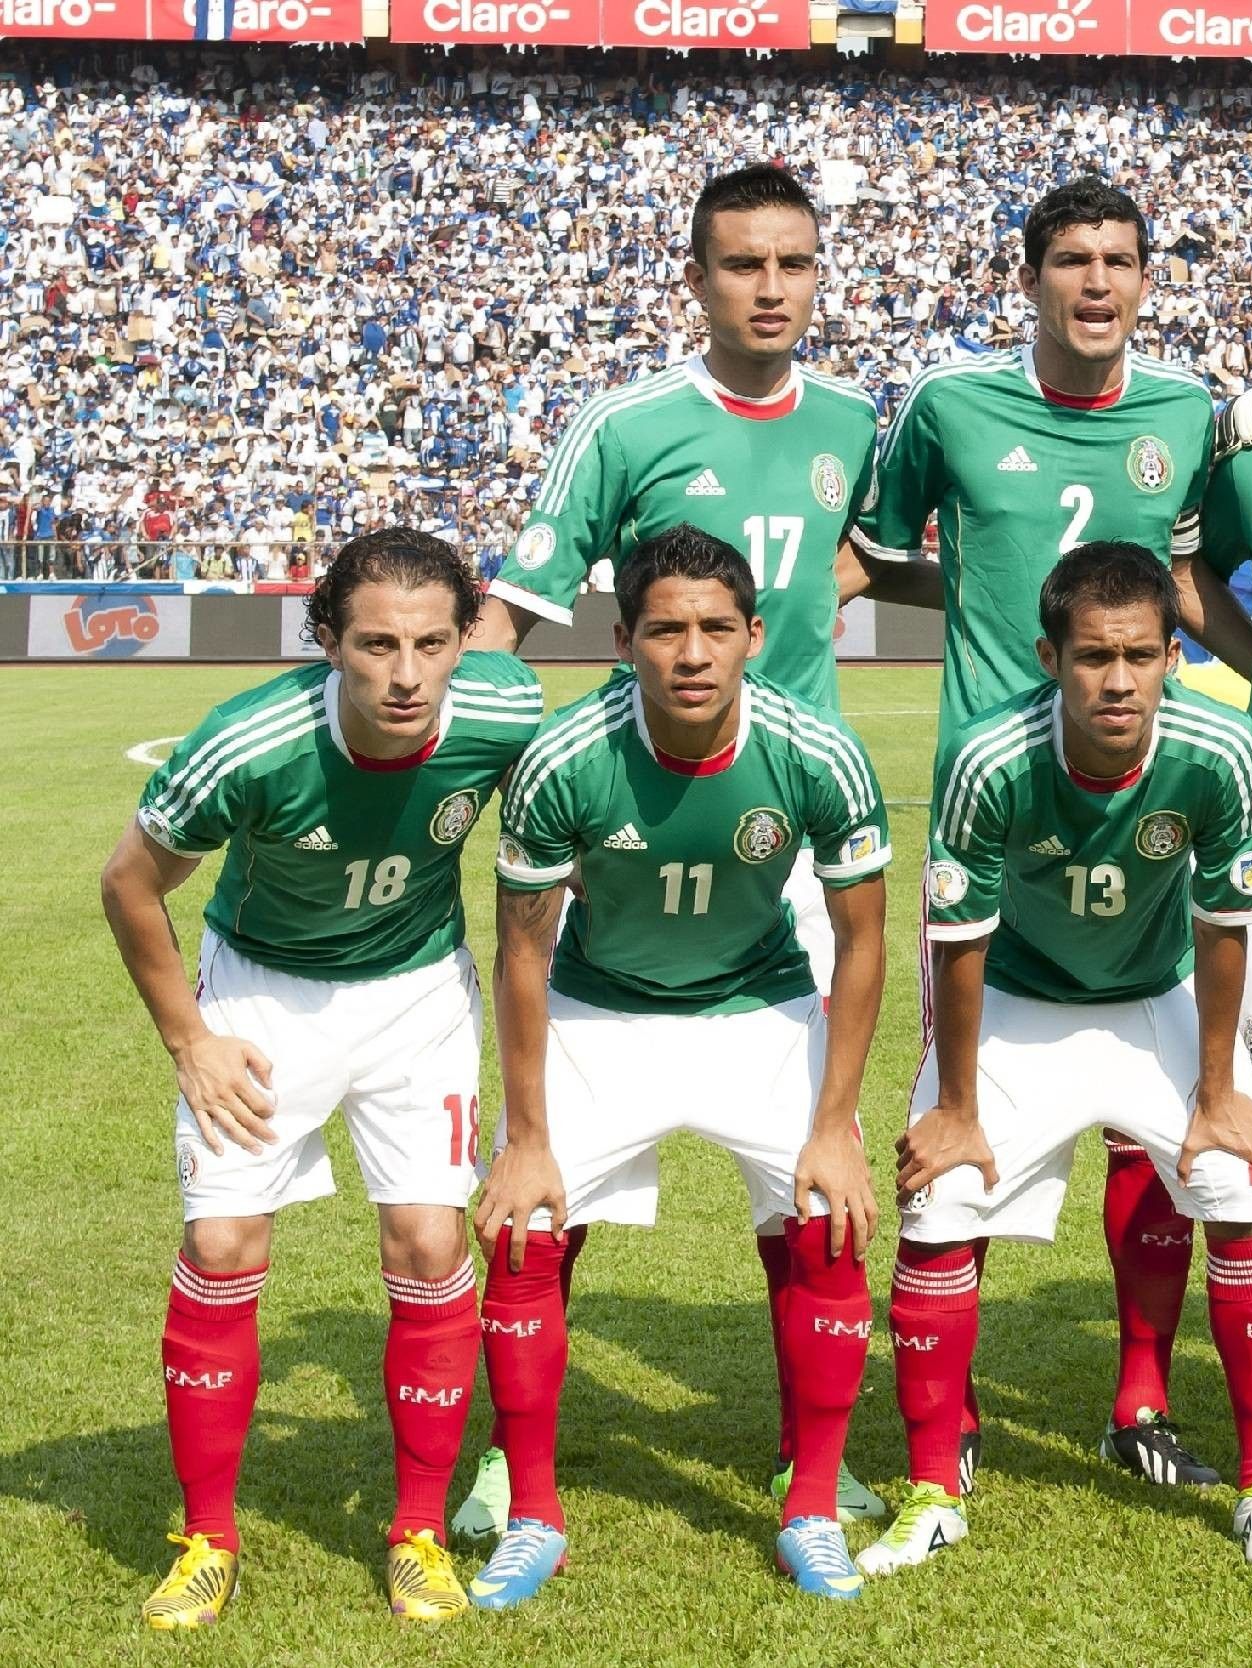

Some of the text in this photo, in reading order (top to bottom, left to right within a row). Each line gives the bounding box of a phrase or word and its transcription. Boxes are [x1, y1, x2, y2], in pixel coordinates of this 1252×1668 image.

[0, 0, 92, 26] laro
[424, 0, 546, 33] Claro
[634, 2, 754, 37] Claro
[956, 5, 1073, 42] Claro
[1059, 484, 1094, 556] 2
[743, 516, 805, 590] 17
[294, 841, 339, 851] adidas
[603, 839, 648, 850] adidas
[343, 854, 412, 910] 18
[659, 862, 714, 914] 11
[1064, 863, 1127, 917] 13
